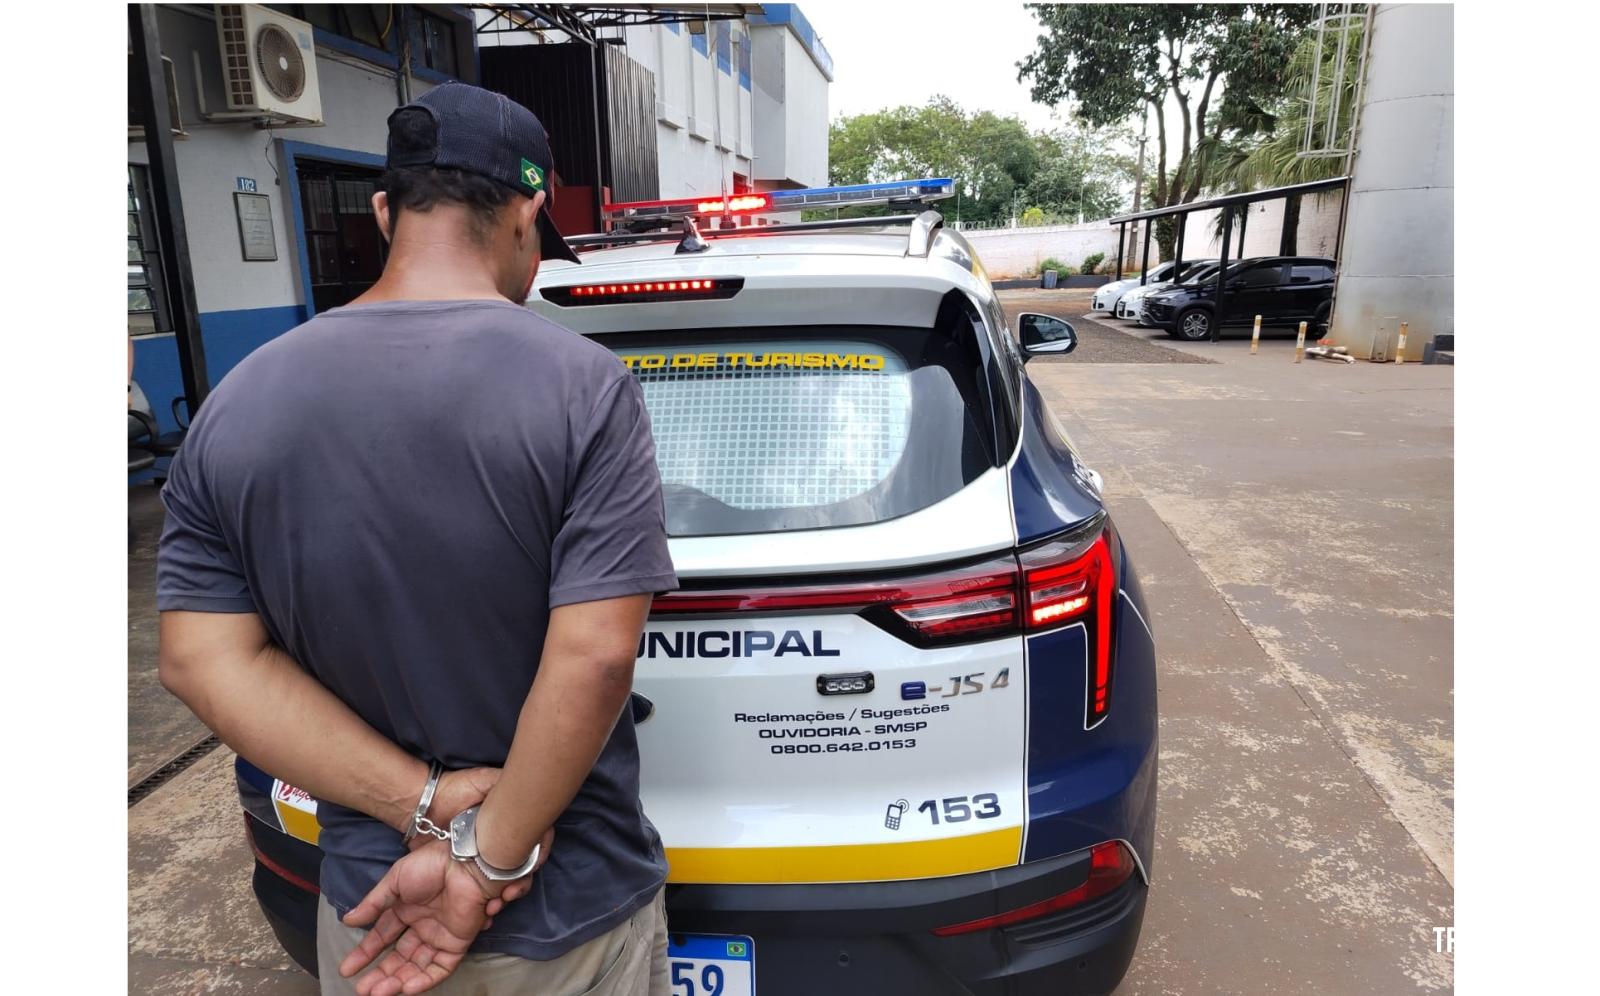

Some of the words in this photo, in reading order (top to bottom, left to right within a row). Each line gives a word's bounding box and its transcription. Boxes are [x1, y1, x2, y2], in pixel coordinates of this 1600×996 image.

[621, 354, 666, 369] TO
[671, 352, 718, 368] DE
[724, 352, 885, 369] TURISMO
[734, 710, 845, 725] Reclamações
[861, 703, 950, 720] Sugestões
[759, 726, 861, 739] OUVIDORIA
[874, 721, 928, 735] SMSP
[771, 738, 916, 755] 0800.642.0153
[918, 792, 1002, 825] 153
